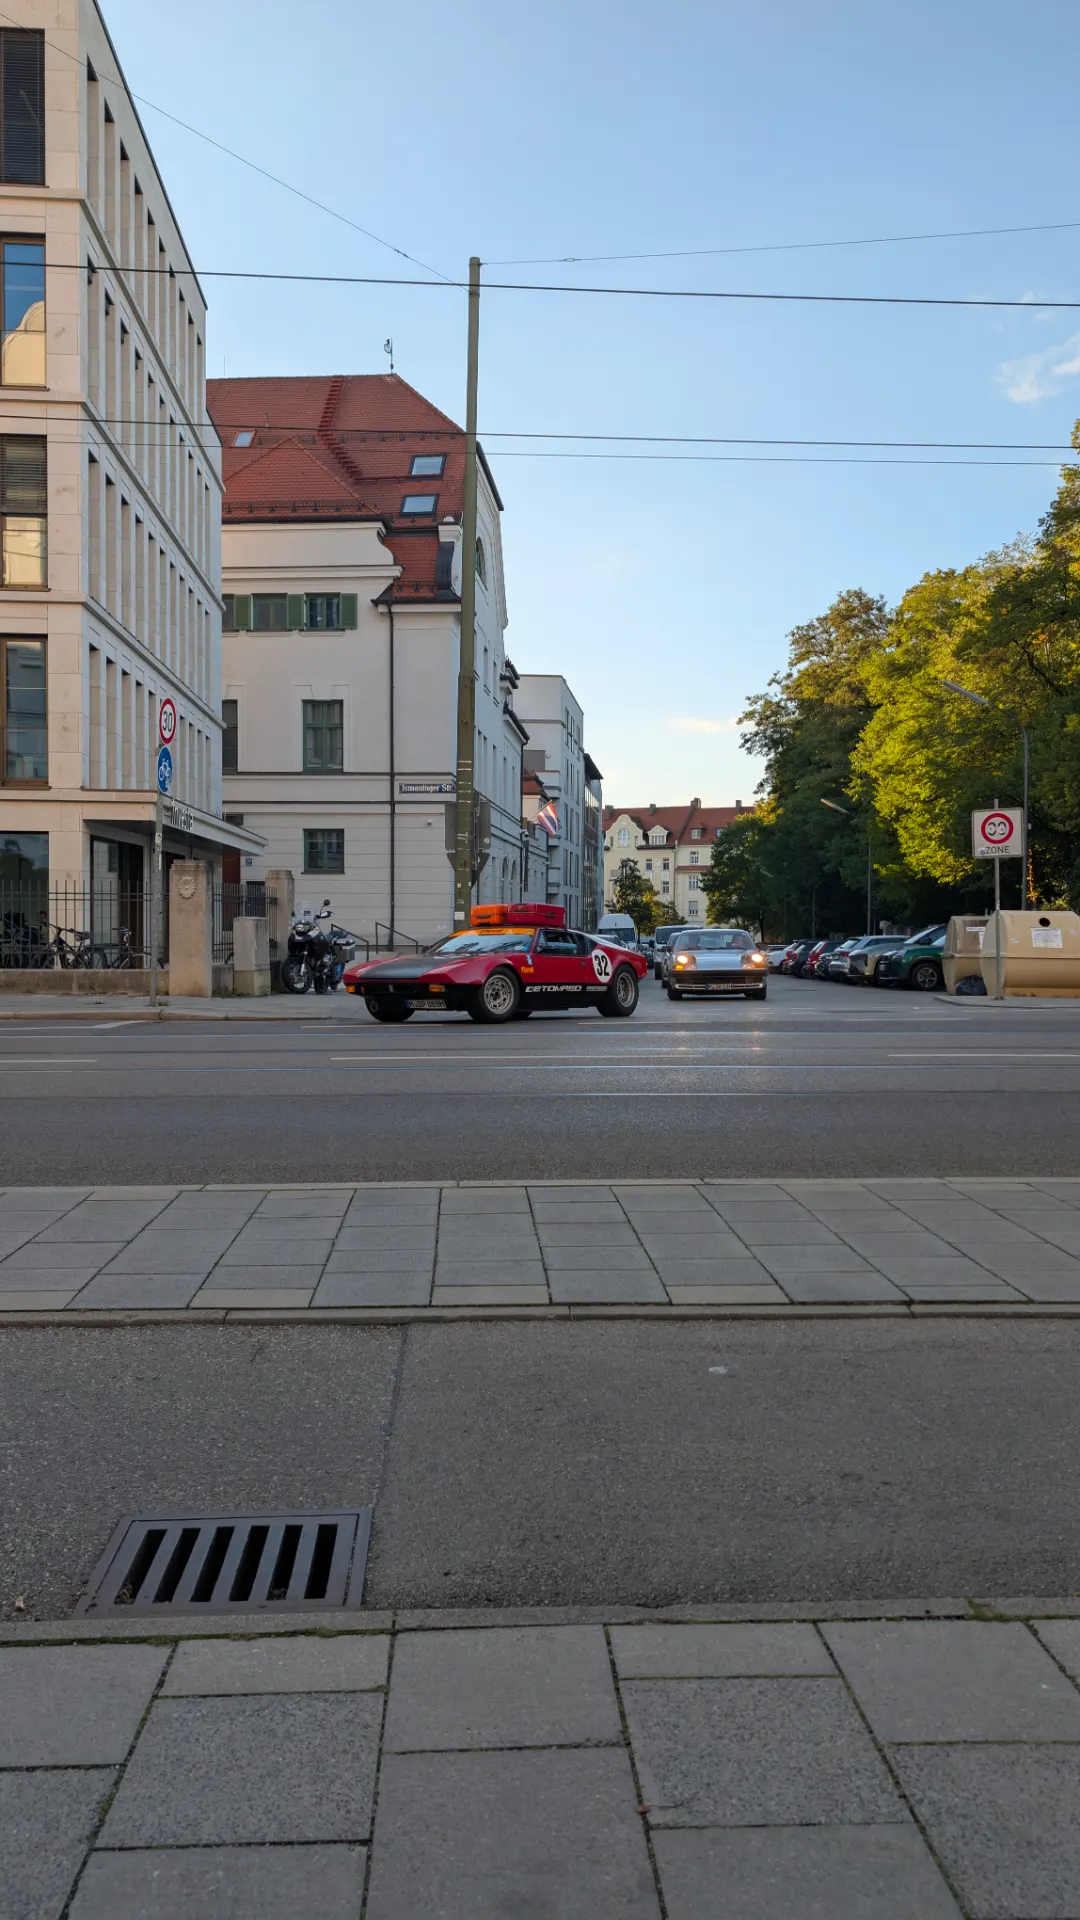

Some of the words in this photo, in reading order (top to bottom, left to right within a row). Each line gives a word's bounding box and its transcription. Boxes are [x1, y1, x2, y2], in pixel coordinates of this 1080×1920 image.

[162, 710, 173, 732] 30
[401, 783, 440, 793] Ismaninger
[985, 845, 1011, 855] ZONE
[593, 954, 611, 977] 32
